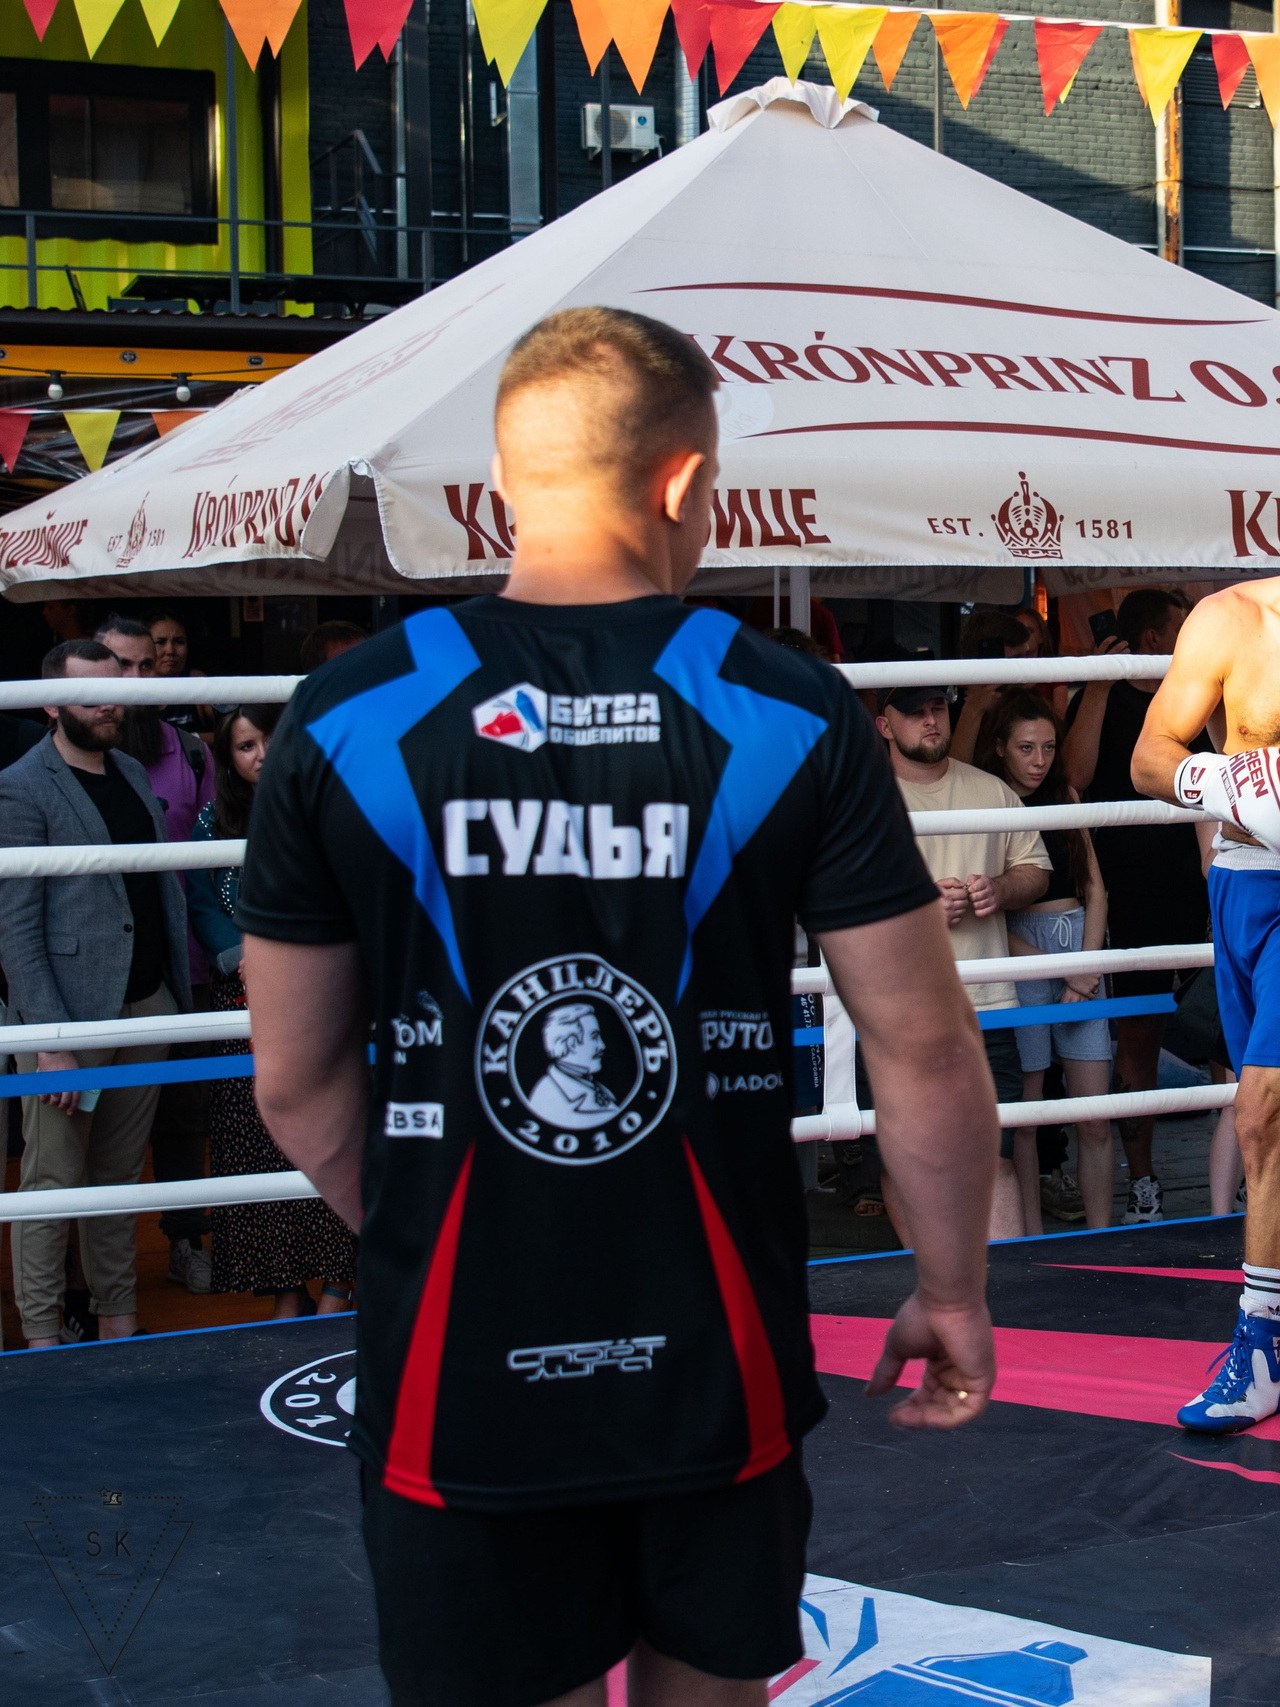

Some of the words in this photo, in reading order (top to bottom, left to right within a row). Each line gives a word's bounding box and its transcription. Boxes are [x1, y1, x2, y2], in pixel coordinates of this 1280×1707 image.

[927, 517, 985, 538] EST.
[1075, 519, 1133, 540] 1581
[550, 692, 662, 727] БИТВА
[1228, 752, 1251, 799] HILL
[442, 798, 690, 880] СУДЬЯ
[483, 962, 669, 1075] КАНЦЛЕРЪ
[516, 1110, 643, 1154] 2010
